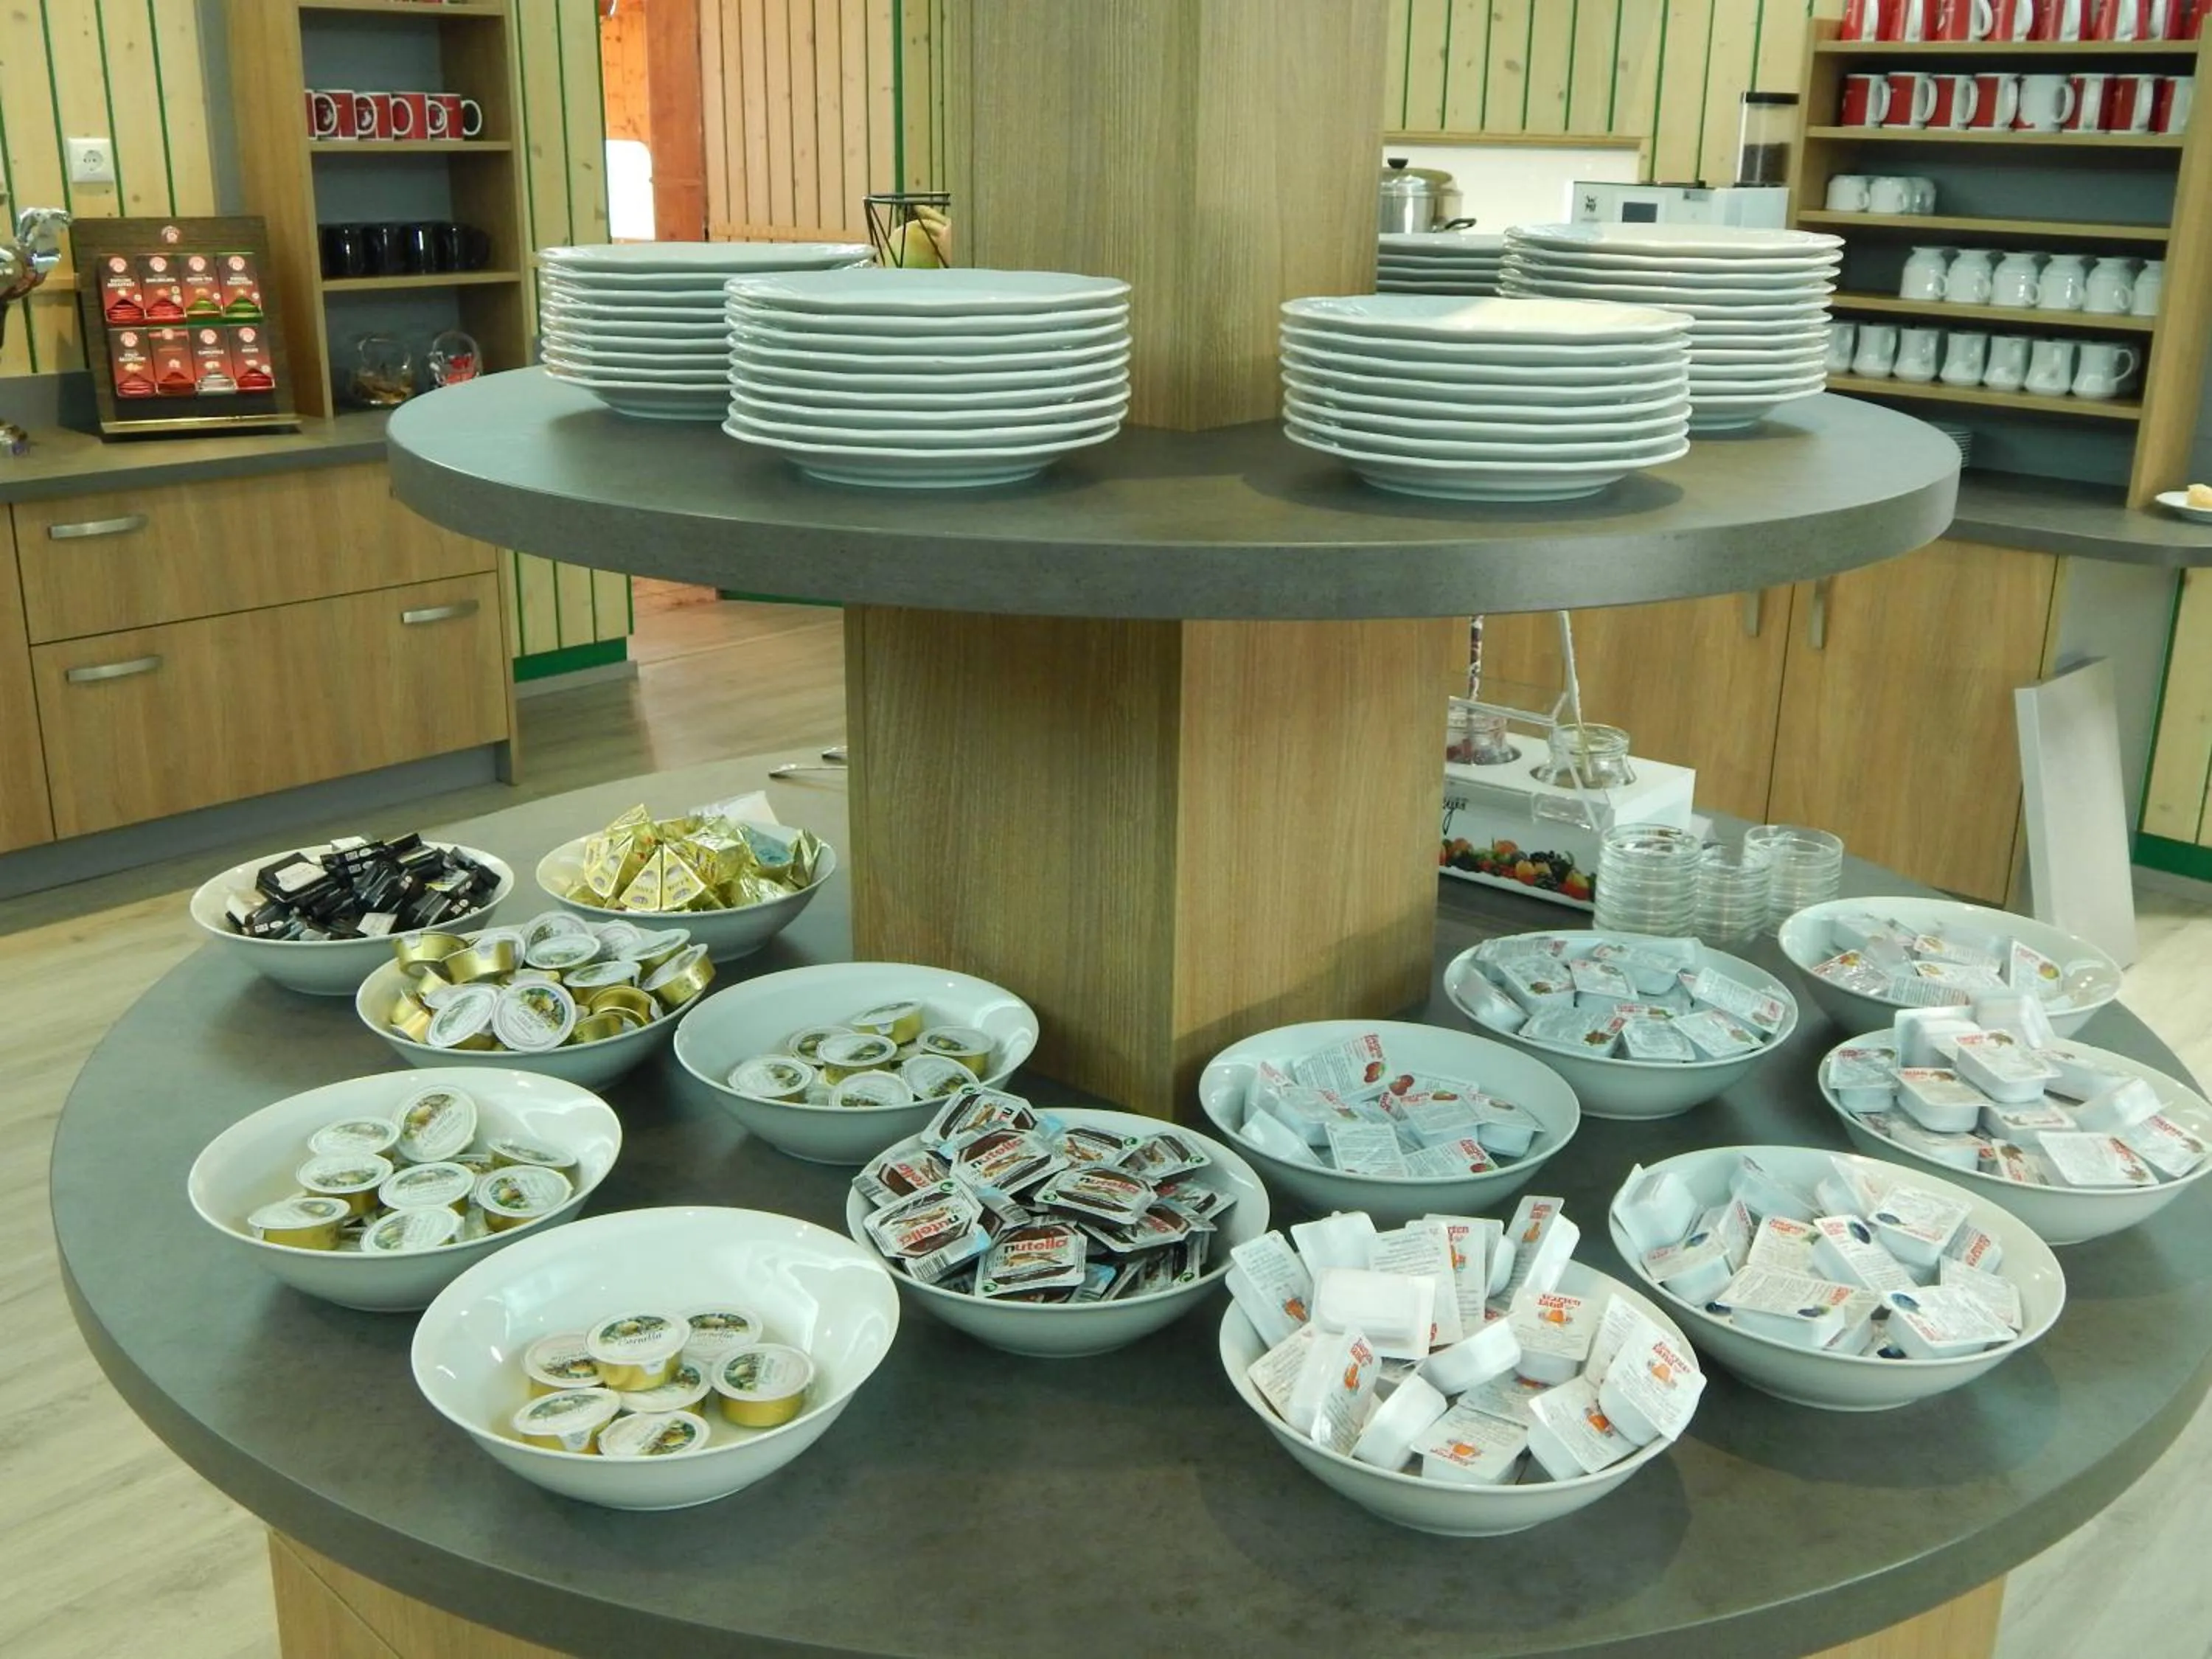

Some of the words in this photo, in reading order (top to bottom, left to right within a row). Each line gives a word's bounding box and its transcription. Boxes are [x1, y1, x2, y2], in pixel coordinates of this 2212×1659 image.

[970, 1137, 1025, 1168] nutella
[1079, 1176, 1141, 1194] nutella
[897, 1214, 959, 1246] nutella
[1004, 1237, 1068, 1253] nutella
